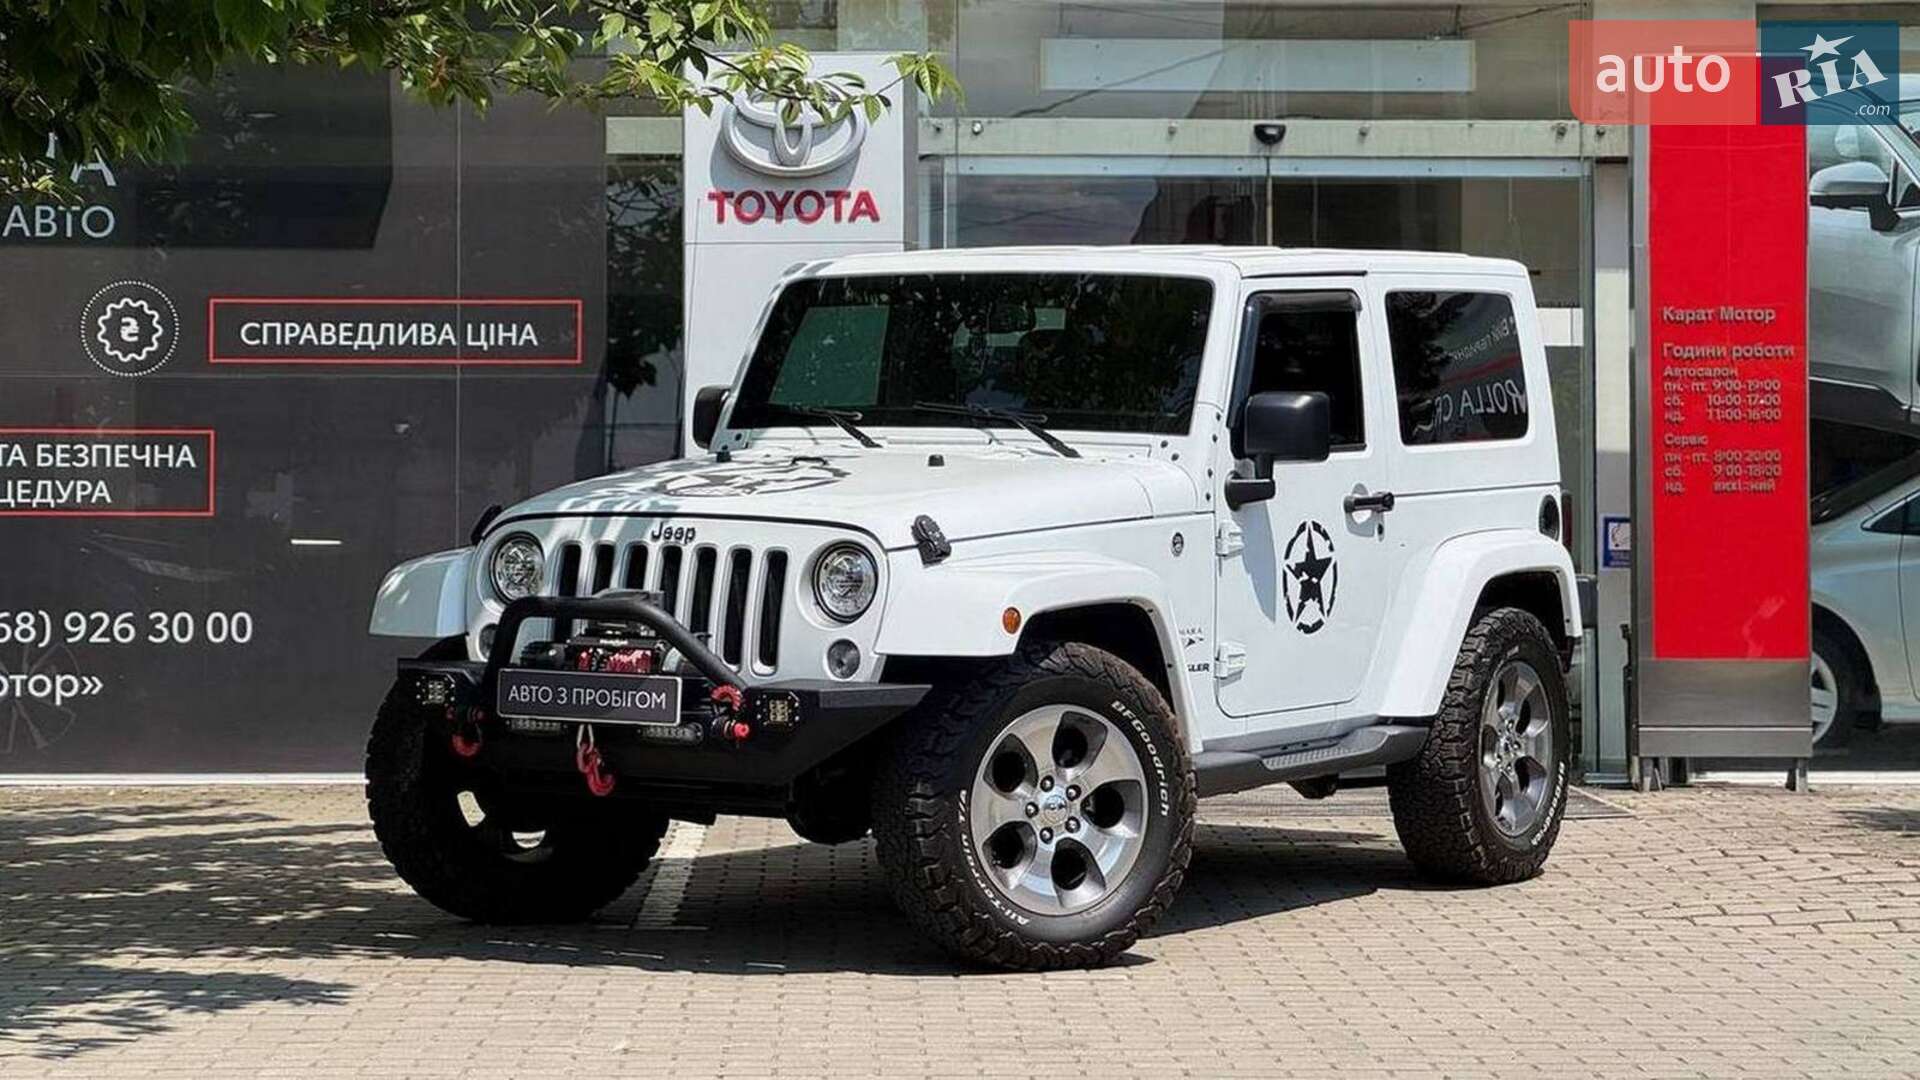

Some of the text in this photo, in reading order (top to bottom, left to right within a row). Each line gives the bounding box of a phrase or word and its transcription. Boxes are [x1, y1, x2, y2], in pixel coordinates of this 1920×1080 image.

[707, 189, 881, 224] TOYOTA
[2, 205, 115, 238] АВТО
[1663, 306, 1776, 323] Карат Мотор
[240, 322, 539, 351] СПРАВЕДЛИВА ЦІНА
[1663, 343, 1794, 359] Години роботи
[36, 443, 197, 468] БЕЗПЕЧНА
[651, 521, 697, 544] Jeep
[64, 611, 136, 643] 926
[148, 611, 194, 643] 30
[206, 611, 253, 643] 00
[508, 684, 667, 710] АВТО З ПРОБІГОМ
[1111, 700, 1169, 817] BFGoodrich
